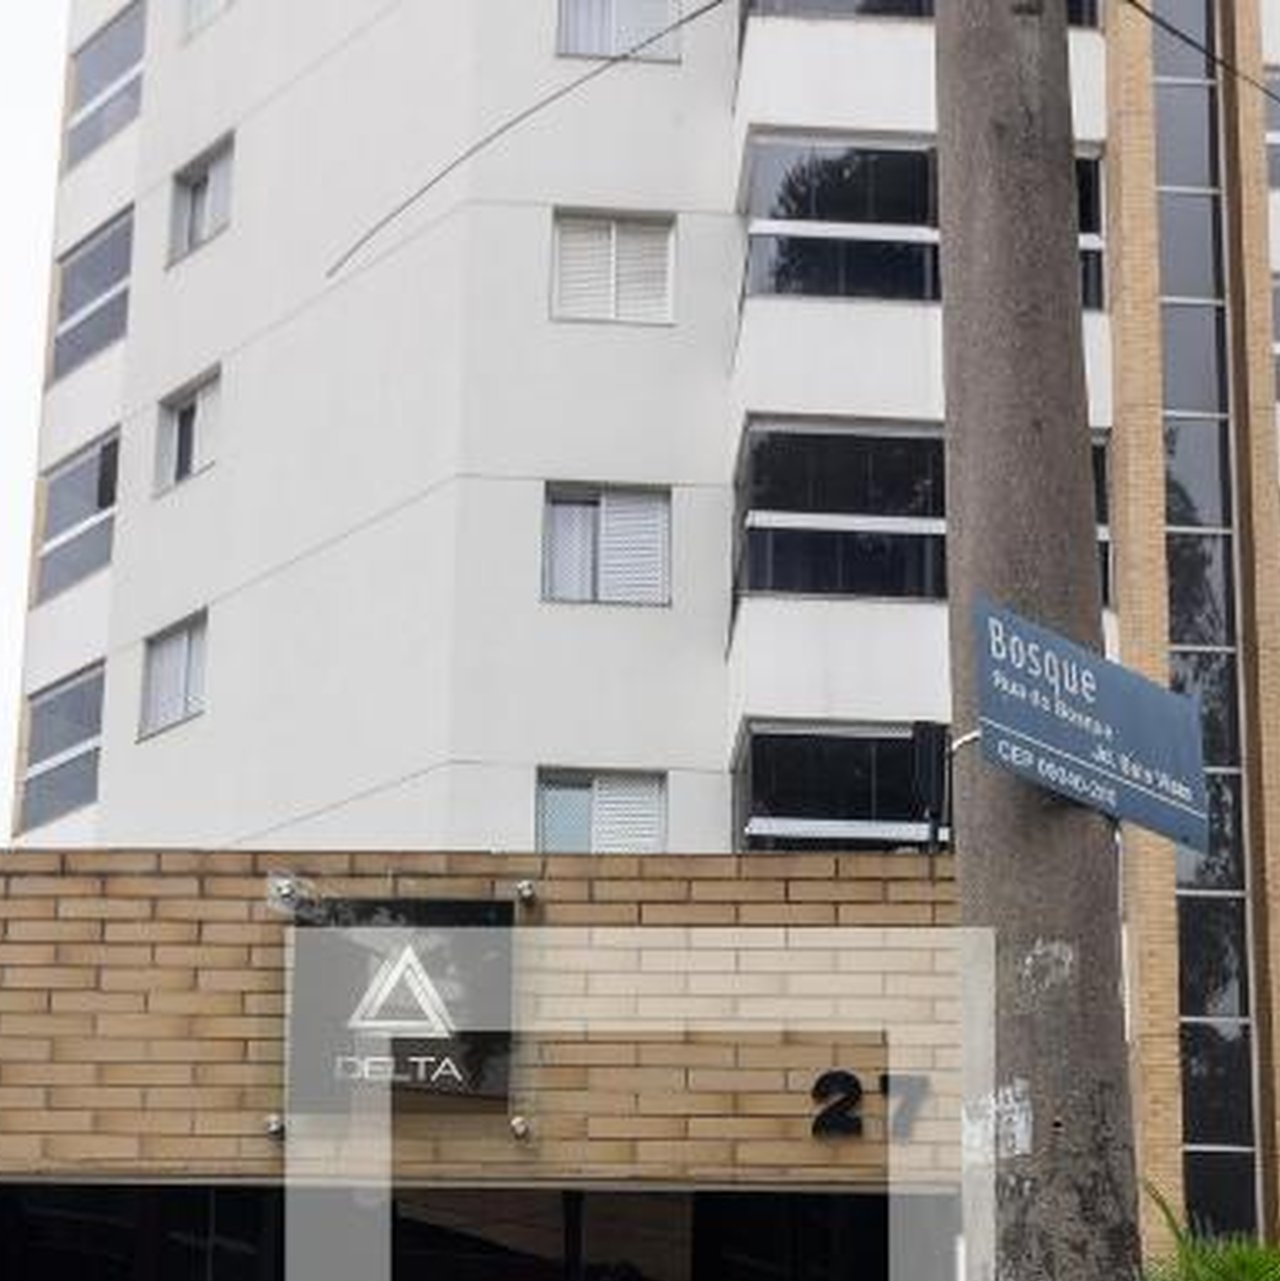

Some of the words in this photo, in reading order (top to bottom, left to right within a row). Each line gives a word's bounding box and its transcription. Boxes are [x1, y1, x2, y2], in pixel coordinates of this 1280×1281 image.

[988, 616, 1096, 702] Bosque
[997, 740, 1034, 767] CEP
[335, 1056, 463, 1082] DELTA
[811, 1070, 931, 1147] 27
